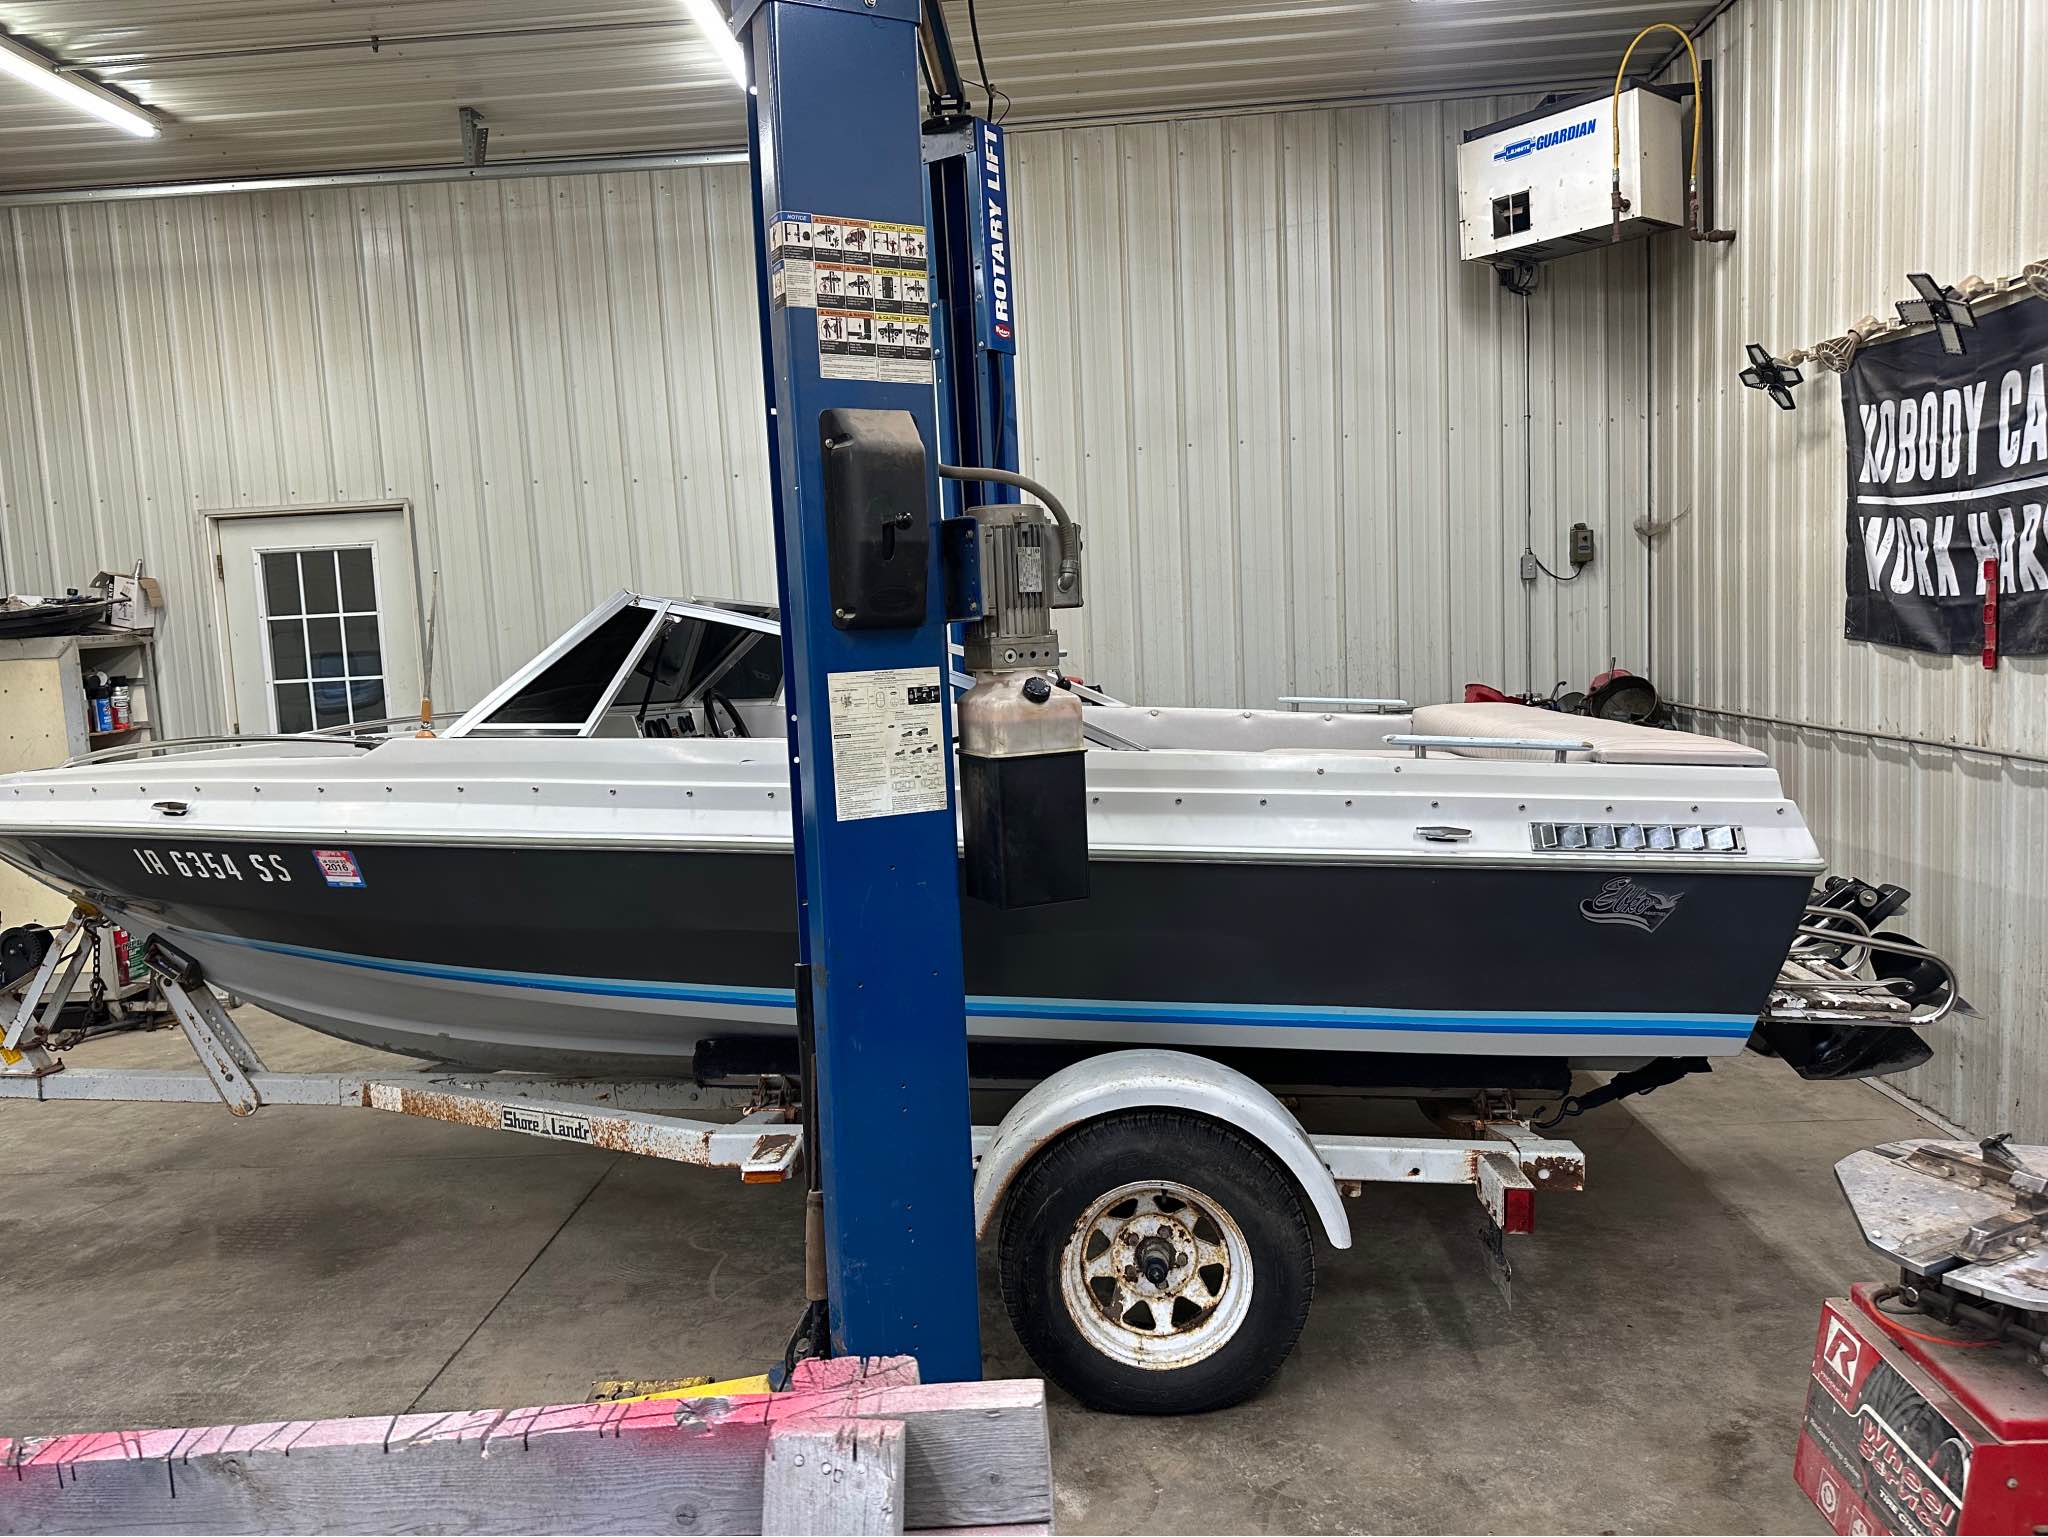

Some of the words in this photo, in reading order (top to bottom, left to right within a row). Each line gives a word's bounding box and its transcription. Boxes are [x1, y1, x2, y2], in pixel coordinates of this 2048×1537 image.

[984, 124, 1001, 192] LIFT
[1536, 118, 1597, 150] GUARDIAN
[988, 197, 1009, 322] ROTARY
[1858, 380, 1988, 484] NOBODY
[1858, 515, 1961, 597] WORK
[1967, 503, 2048, 597] HAR
[133, 848, 169, 876] IA
[168, 850, 244, 881] 6354
[248, 853, 292, 882] SS
[325, 863, 349, 872] 2016
[503, 1110, 539, 1133] Shore
[551, 1117, 590, 1140] Land'r
[1825, 1327, 1858, 1382] R
[1863, 1416, 1956, 1527] Wheel
[1898, 1512, 1921, 1536] CHA
